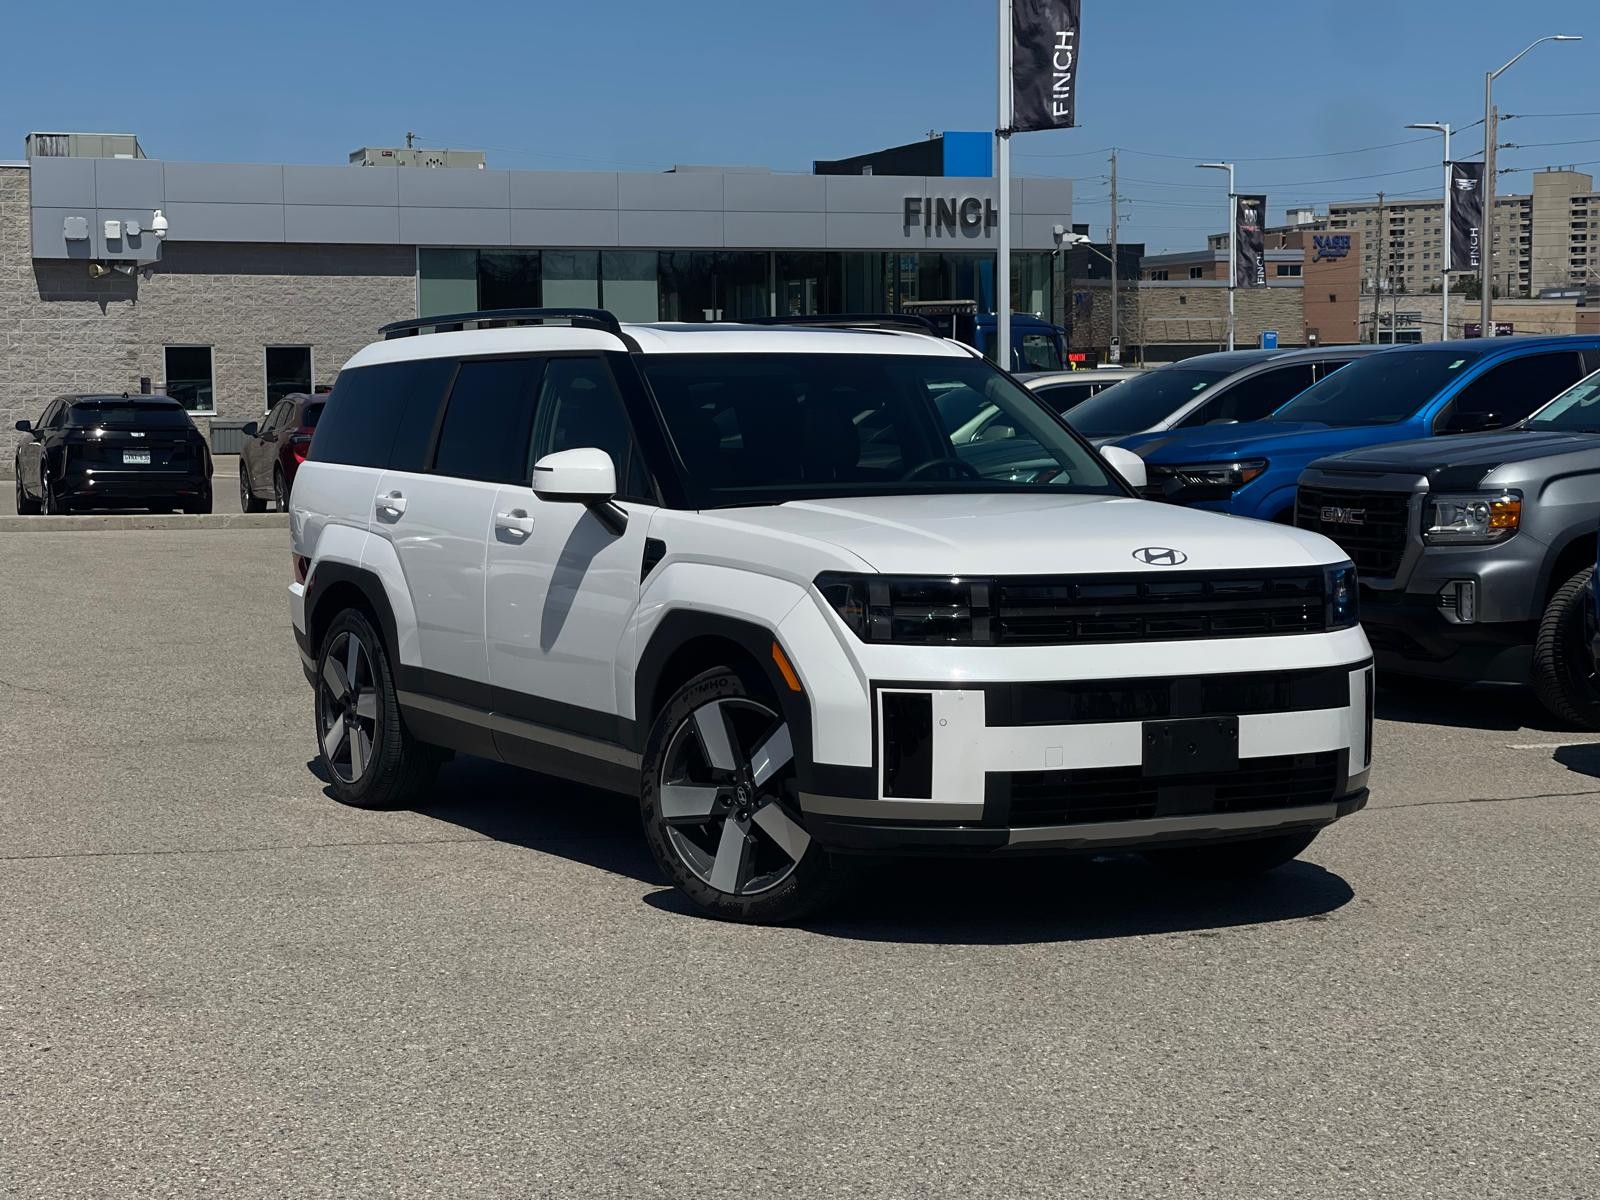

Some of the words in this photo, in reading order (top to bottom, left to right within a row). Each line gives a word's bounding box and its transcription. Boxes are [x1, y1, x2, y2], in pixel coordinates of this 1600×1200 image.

[1053, 31, 1074, 116] FINCH
[1470, 227, 1480, 266] FINCH
[1320, 506, 1366, 525] GMC
